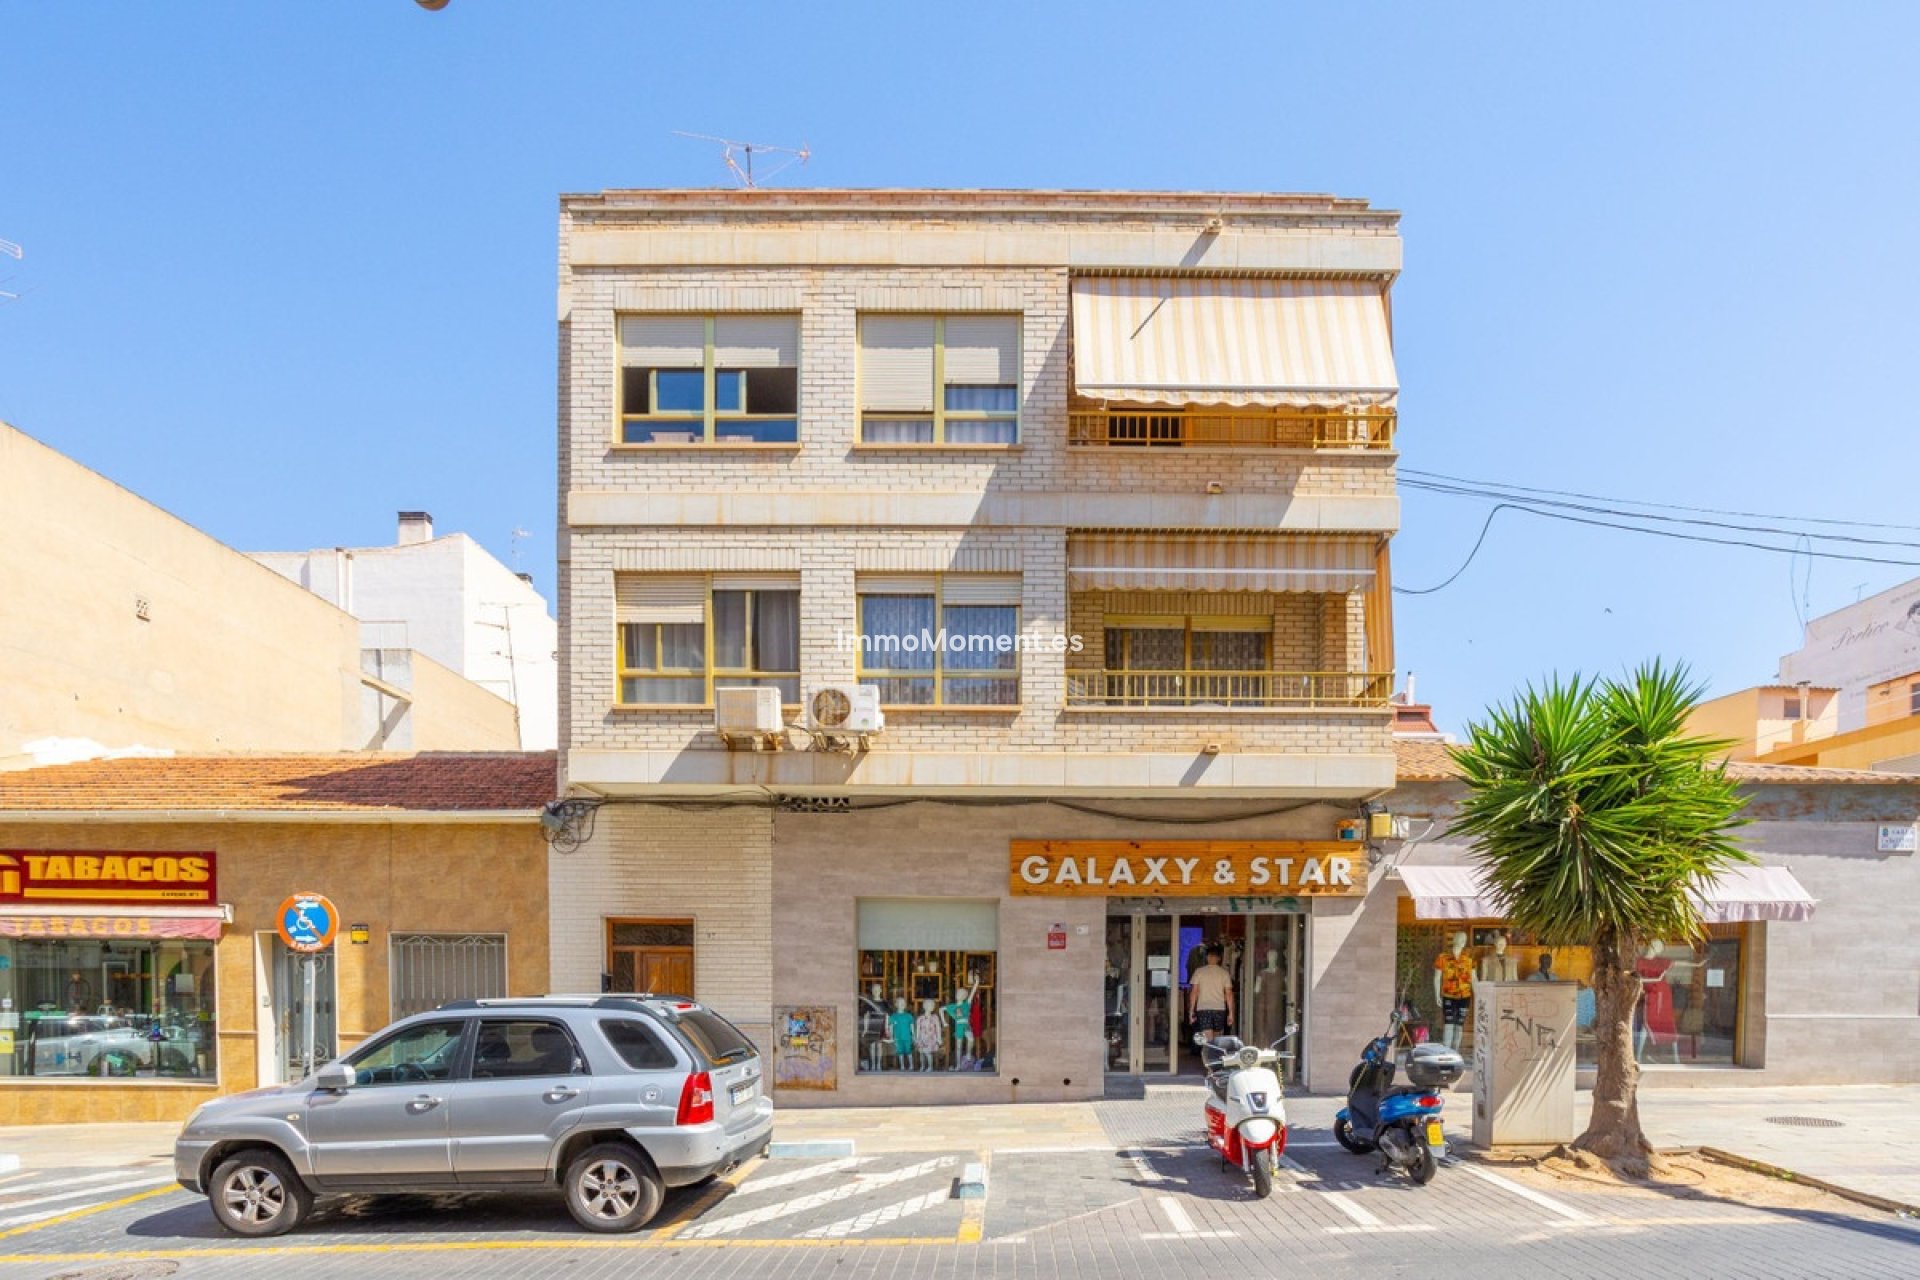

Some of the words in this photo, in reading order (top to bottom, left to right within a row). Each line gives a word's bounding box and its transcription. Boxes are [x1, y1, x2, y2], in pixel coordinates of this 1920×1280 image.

[24, 855, 209, 882] TABACOS
[1020, 855, 1200, 885] GALAXY
[1213, 859, 1236, 885] &
[1250, 857, 1354, 886] STAR
[14, 917, 152, 935] TABACOS
